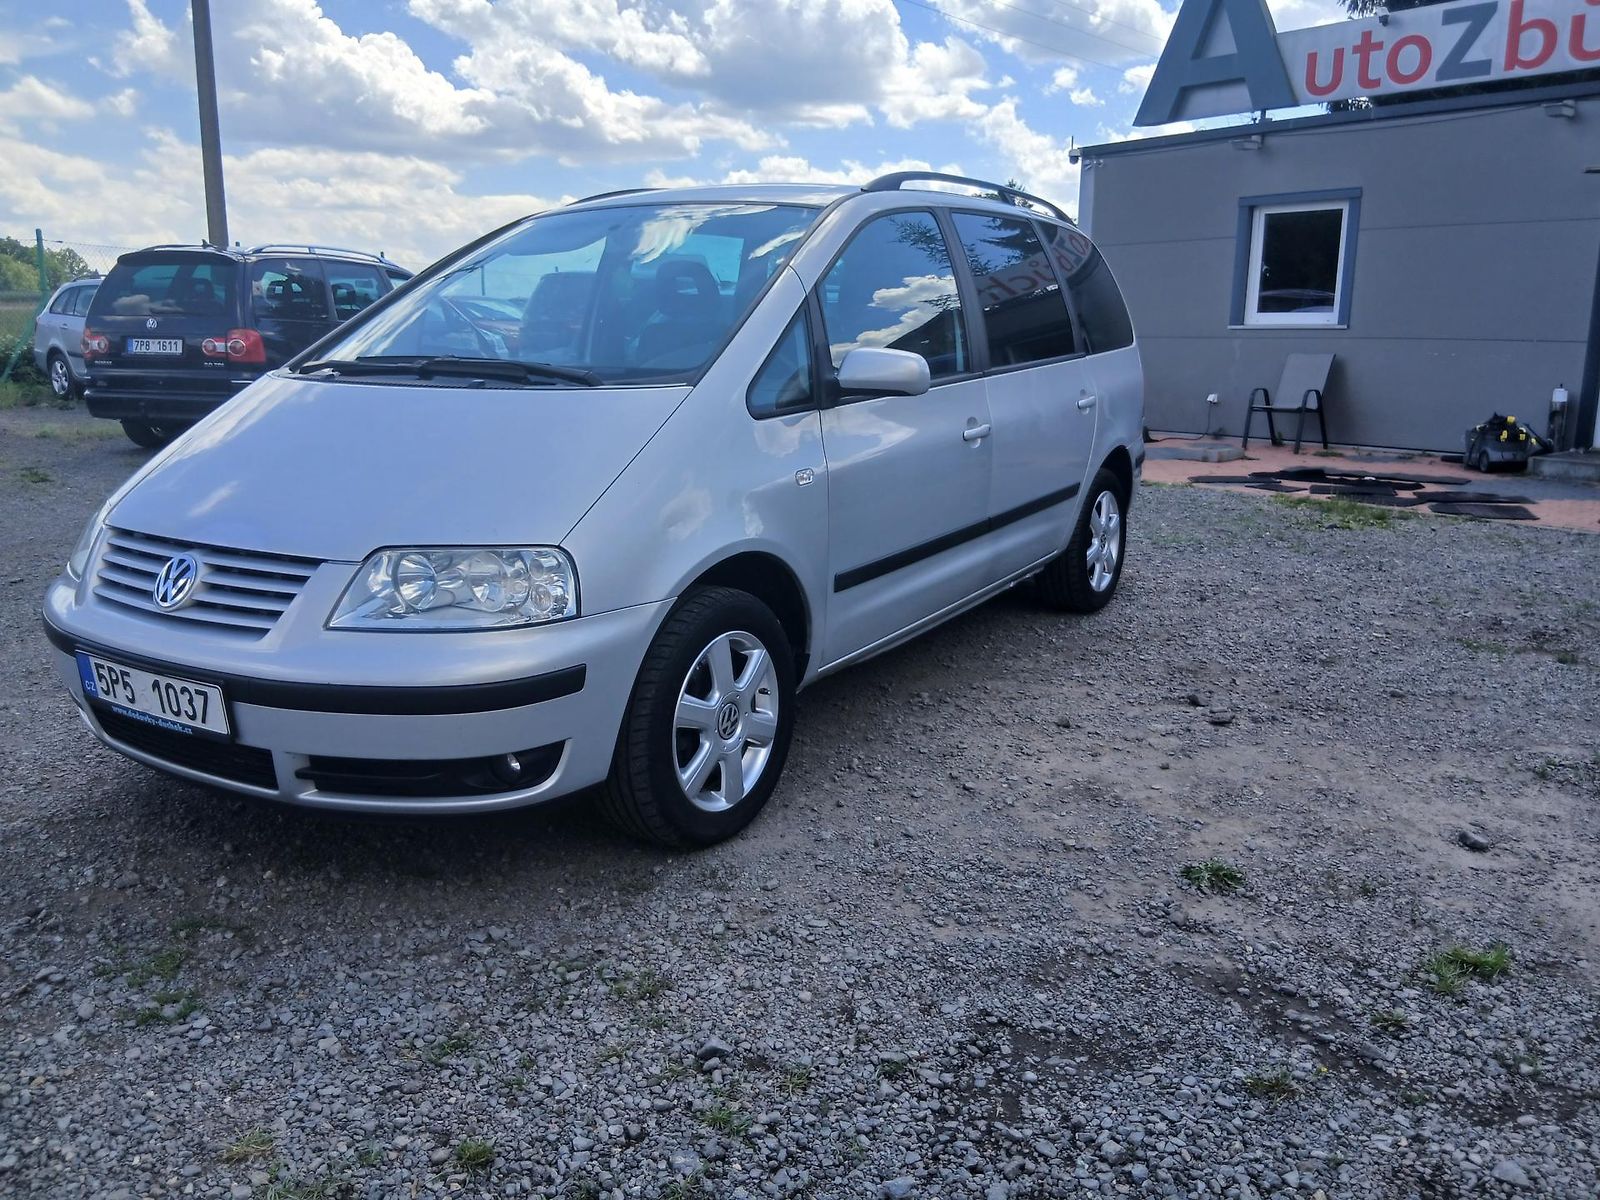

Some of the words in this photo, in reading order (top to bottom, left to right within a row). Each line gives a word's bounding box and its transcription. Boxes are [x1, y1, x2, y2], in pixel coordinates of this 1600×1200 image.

[134, 340, 151, 351] 7P8
[157, 340, 178, 351] 1611
[85, 680, 96, 692] CZ
[94, 661, 136, 704] 5P5
[151, 679, 208, 724] 1037
